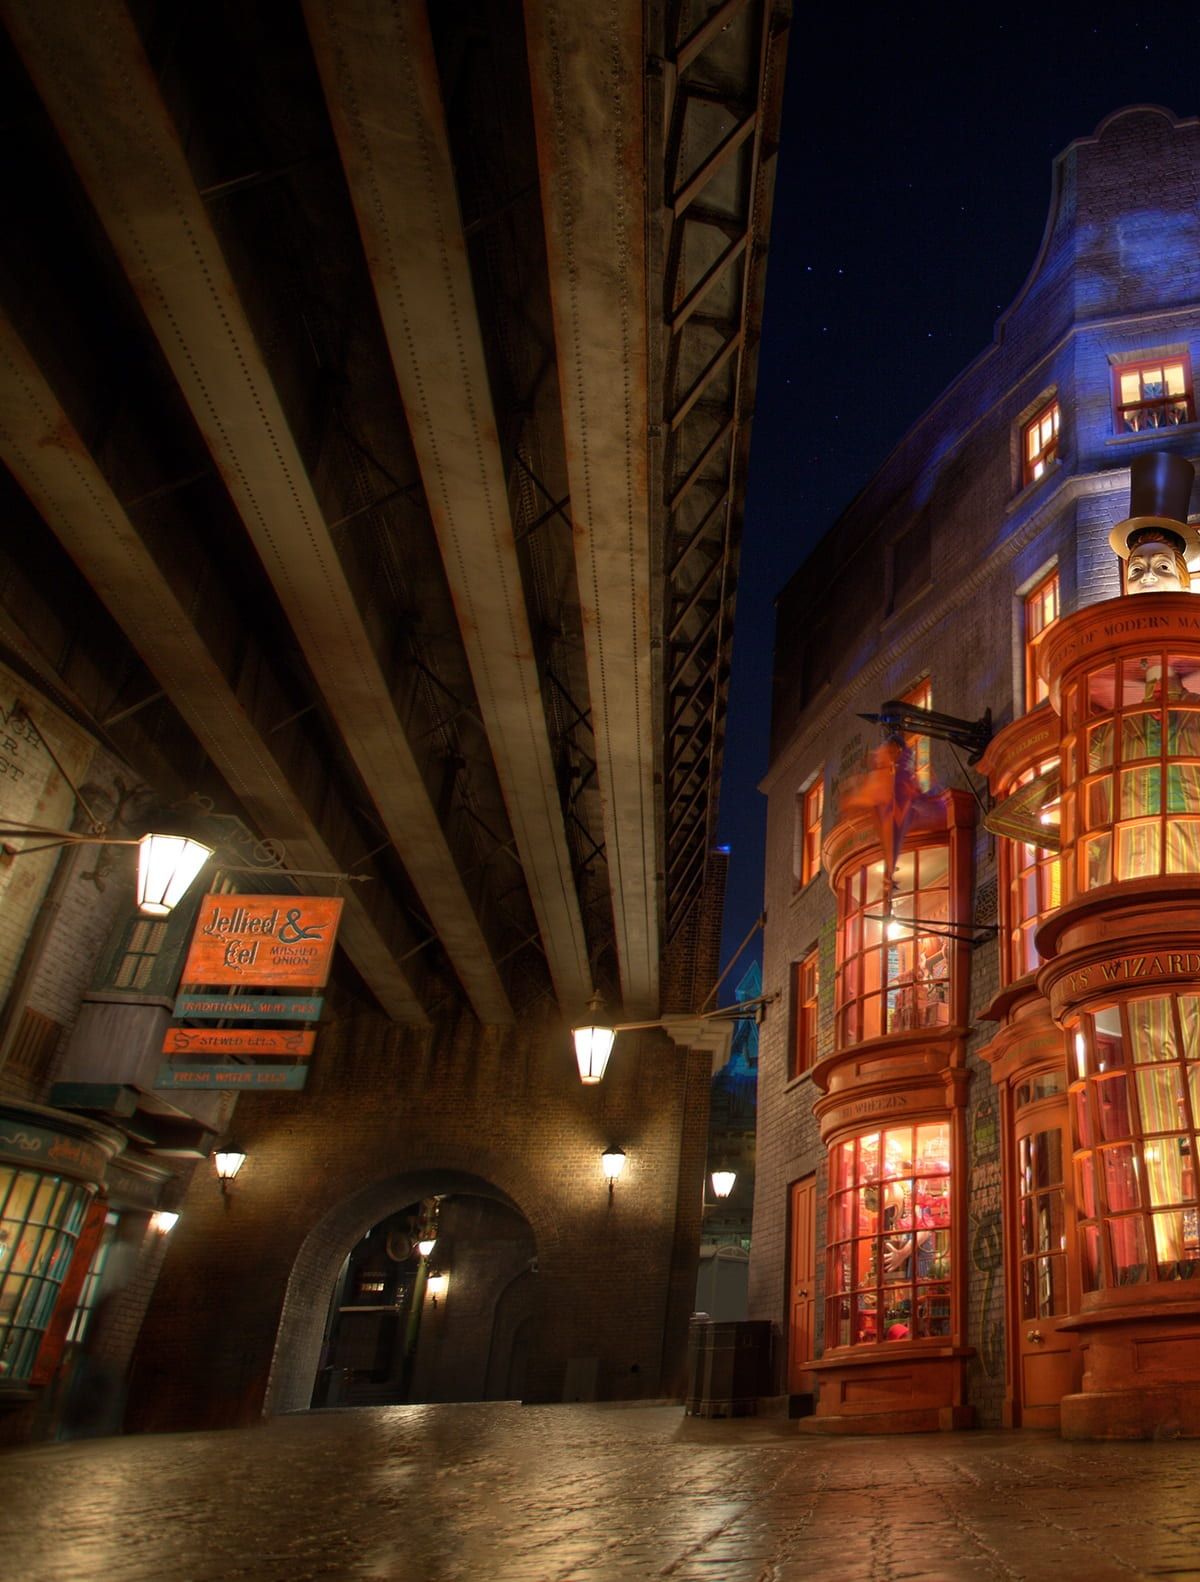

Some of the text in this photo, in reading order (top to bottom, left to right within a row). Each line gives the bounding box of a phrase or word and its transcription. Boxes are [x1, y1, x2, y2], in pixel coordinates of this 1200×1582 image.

[1104, 615, 1170, 636] MODERN
[202, 907, 329, 943] Jellied &
[223, 939, 260, 975] Eel
[272, 956, 309, 967] ONION
